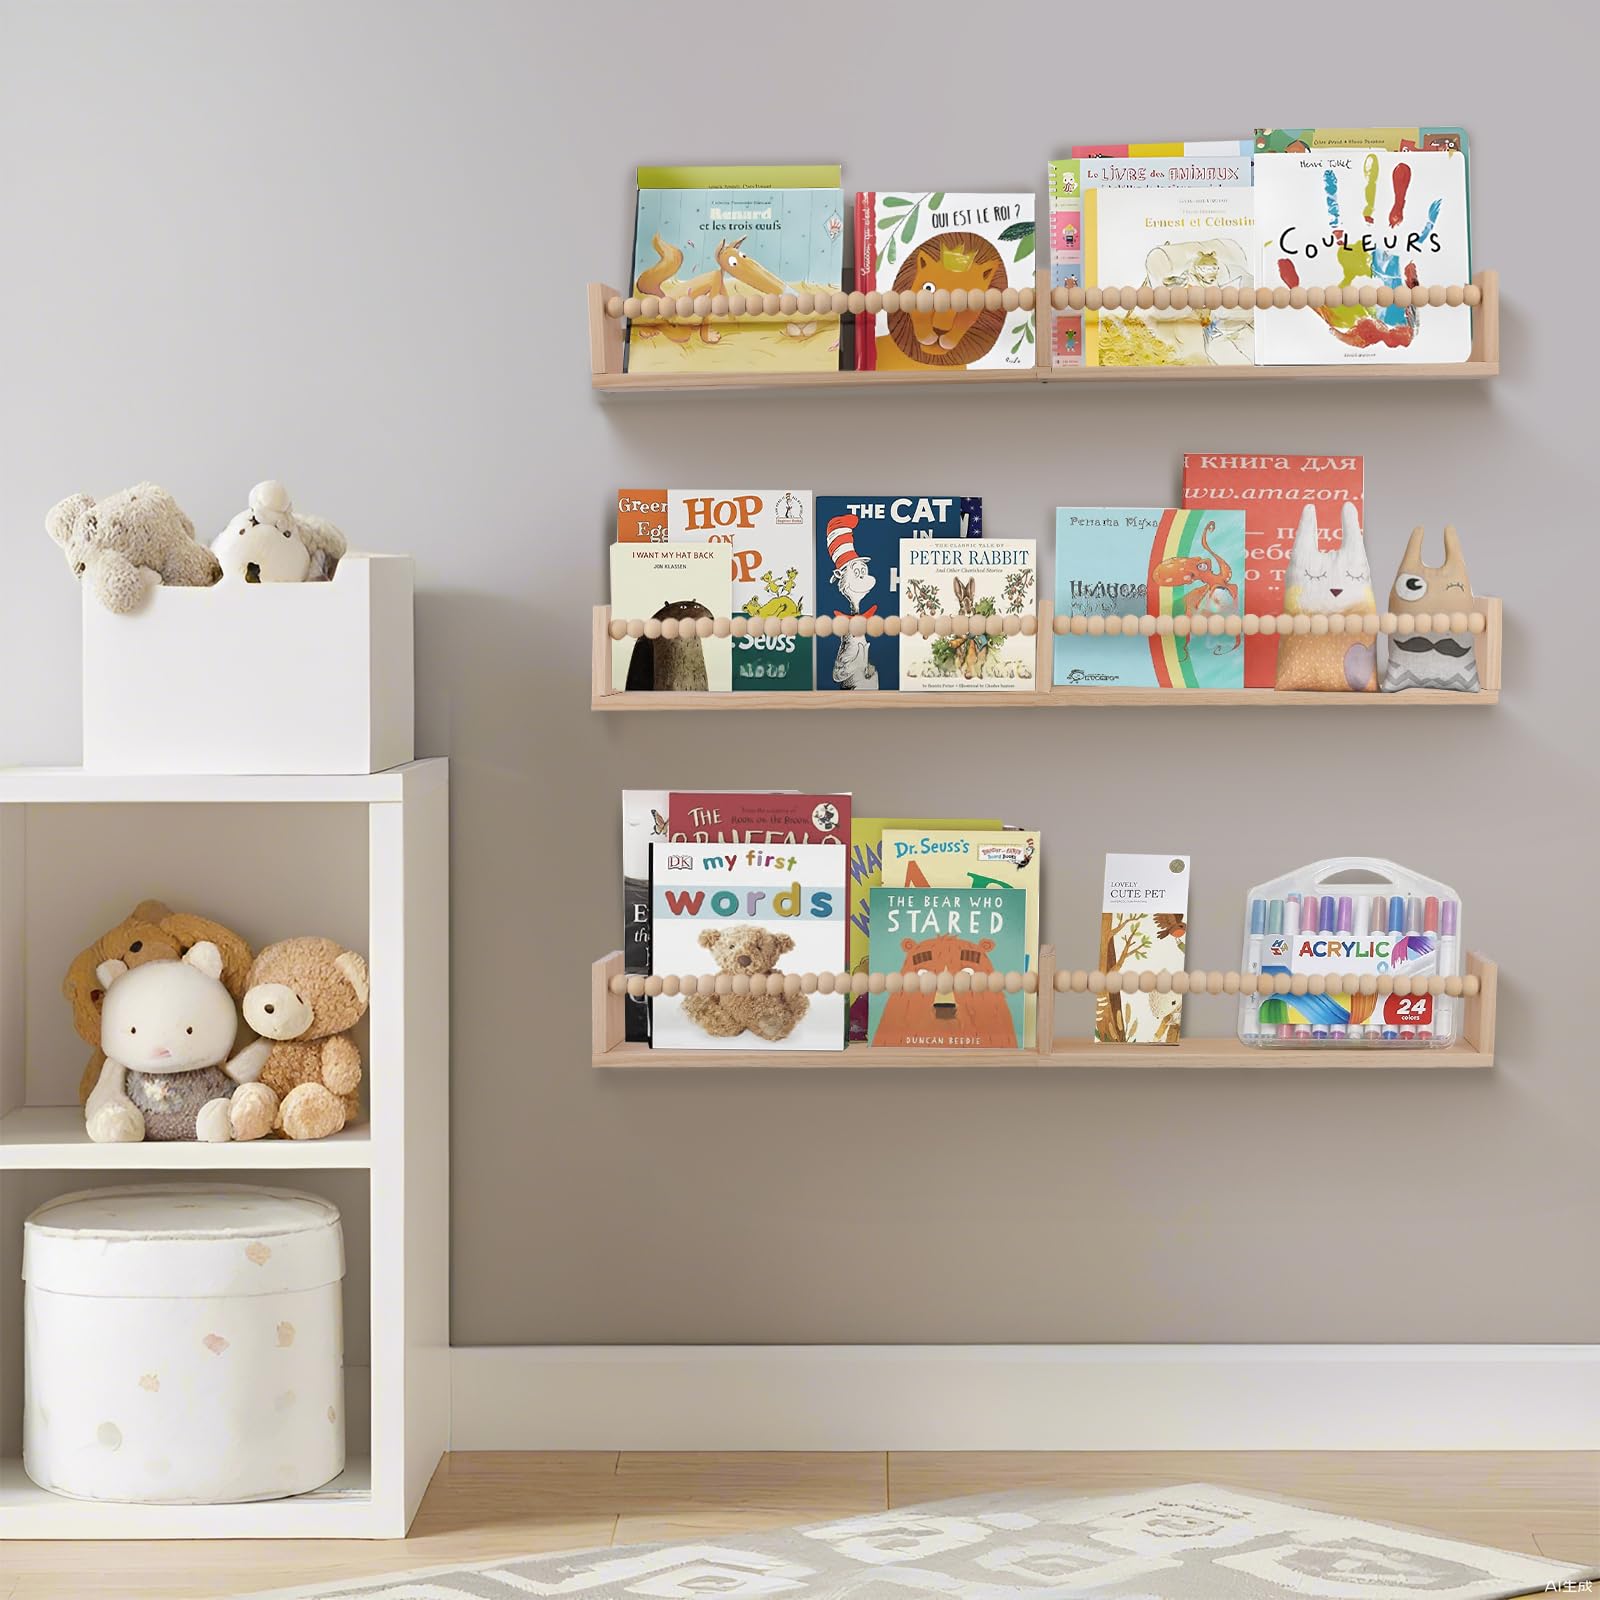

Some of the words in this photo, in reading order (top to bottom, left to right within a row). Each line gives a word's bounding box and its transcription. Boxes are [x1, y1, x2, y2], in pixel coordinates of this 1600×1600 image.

[699, 222, 710, 231] et
[712, 220, 727, 231] les
[729, 220, 753, 231] trois
[931, 212, 949, 229] QUI
[953, 209, 972, 226] EST
[976, 207, 990, 224] LE
[993, 205, 1011, 221] ROI
[1145, 217, 1185, 228] Ernest
[1190, 216, 1201, 228] et
[1279, 226, 1441, 259] COULEURS
[1201, 456, 1291, 470] книга
[1300, 457, 1357, 472] для
[682, 495, 764, 532] HOP
[847, 504, 886, 519] THE
[890, 498, 953, 523] CAT
[636, 551, 659, 559] WANT
[661, 551, 674, 559] MY
[675, 551, 692, 559] HAT
[693, 551, 714, 559] BACK
[910, 550, 963, 566] PETER
[968, 550, 1030, 566] RABBIT
[688, 807, 722, 828] THE
[894, 841, 918, 858] Dr.
[920, 837, 970, 855] Seuss's
[669, 855, 691, 867] DK
[702, 854, 737, 872] my
[745, 850, 798, 872] first
[664, 881, 834, 918] words
[888, 895, 914, 908] THE
[924, 895, 961, 908] BEAR
[969, 896, 1003, 908] WHO
[1110, 889, 1142, 899] CUTE
[1144, 889, 1167, 899] PET
[887, 908, 1004, 935] STARED
[1299, 940, 1391, 958] ACRYLIC
[1396, 998, 1427, 1015] 24
[906, 1036, 944, 1045] DUNCAN
